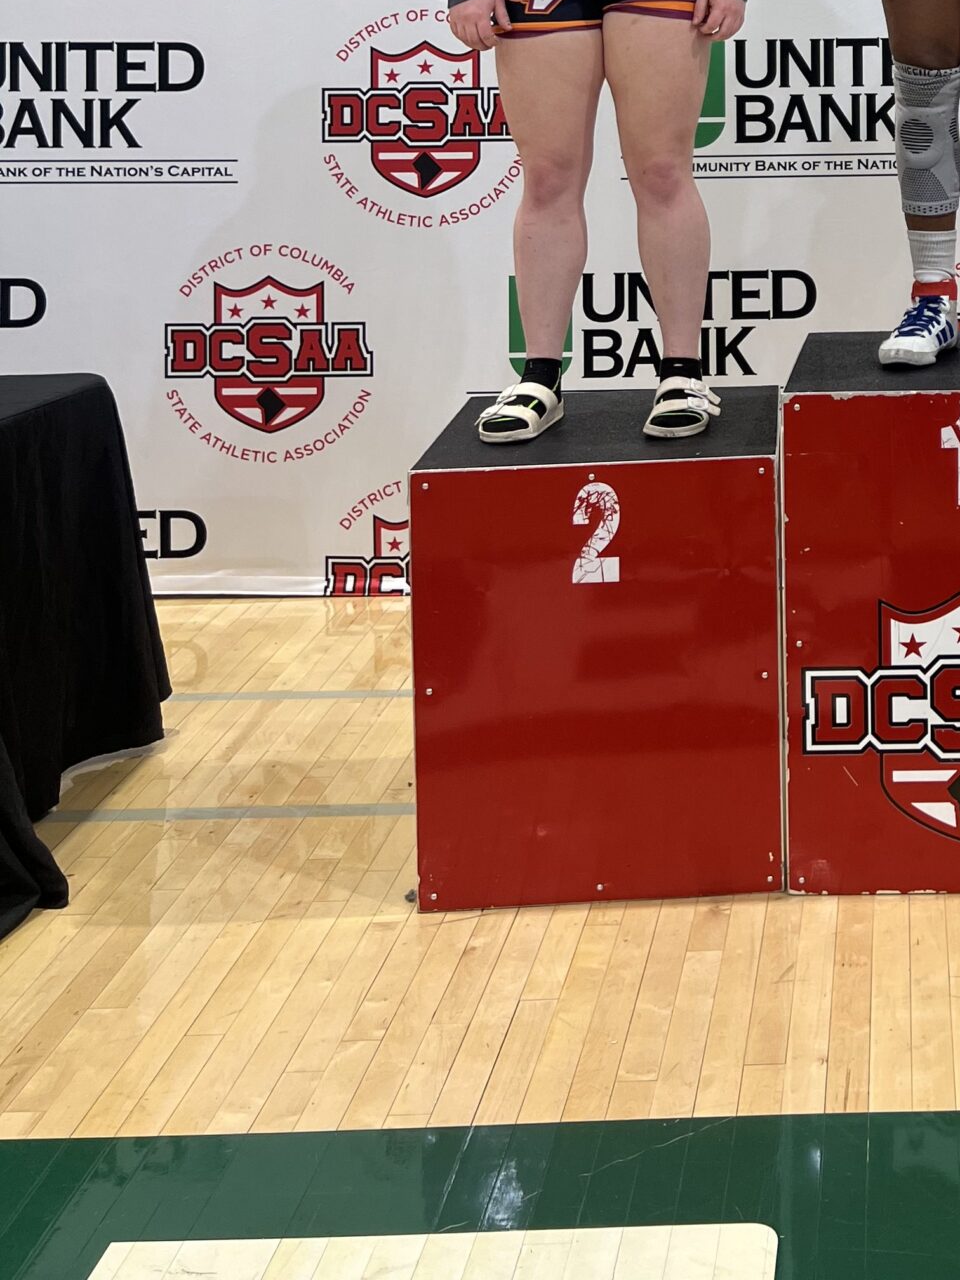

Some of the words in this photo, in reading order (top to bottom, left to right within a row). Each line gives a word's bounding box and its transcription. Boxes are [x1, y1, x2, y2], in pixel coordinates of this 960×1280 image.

[336, 13, 400, 62] DISTRICT
[406, 9, 429, 22] OF
[0, 41, 204, 92] NITED
[0, 98, 142, 148] ANK
[323, 154, 359, 198] STATE
[356, 197, 433, 228] ATHLETIC
[179, 248, 244, 297] DISTRICT
[250, 244, 273, 256] OF
[278, 245, 355, 295] COLUMBIA
[582, 269, 817, 323] UNTED
[165, 317, 373, 384] DCSAA
[167, 389, 202, 434] STATE
[200, 432, 277, 463] ATHLETIC
[283, 389, 372, 462] ASSOCIATION
[339, 481, 402, 530] DISTRICT
[571, 482, 621, 584] 2
